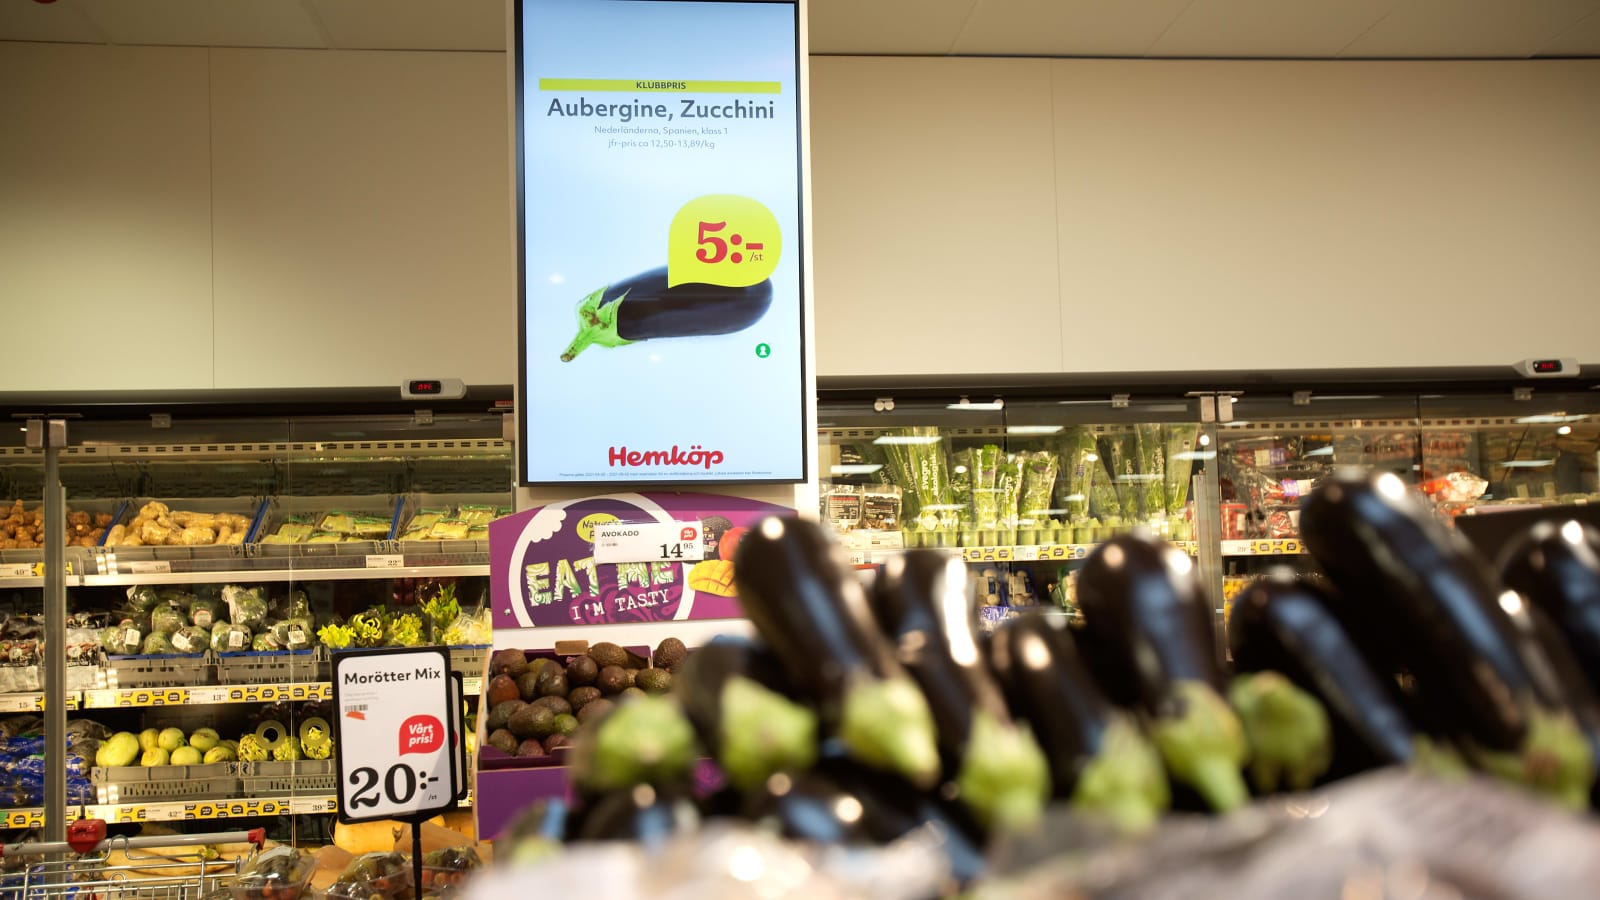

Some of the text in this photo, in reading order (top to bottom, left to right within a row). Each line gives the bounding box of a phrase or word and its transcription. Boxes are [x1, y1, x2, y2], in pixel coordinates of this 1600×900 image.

[636, 81, 687, 90] KLUBBPRIS
[547, 97, 775, 122] Aubergine, Zucchini
[594, 126, 661, 135] Nederländerna,
[663, 127, 699, 136] Spanien,
[701, 127, 722, 135] klass
[608, 138, 637, 149] jfr-pris
[696, 221, 763, 264] 5:-
[608, 445, 724, 469] Hemköp
[525, 556, 600, 607] EAT
[571, 589, 669, 620] I'M TASTY
[344, 667, 441, 685] Morötter Mix
[408, 723, 433, 736] Vårt
[408, 735, 433, 747] pris!
[349, 763, 439, 810] 20:-
